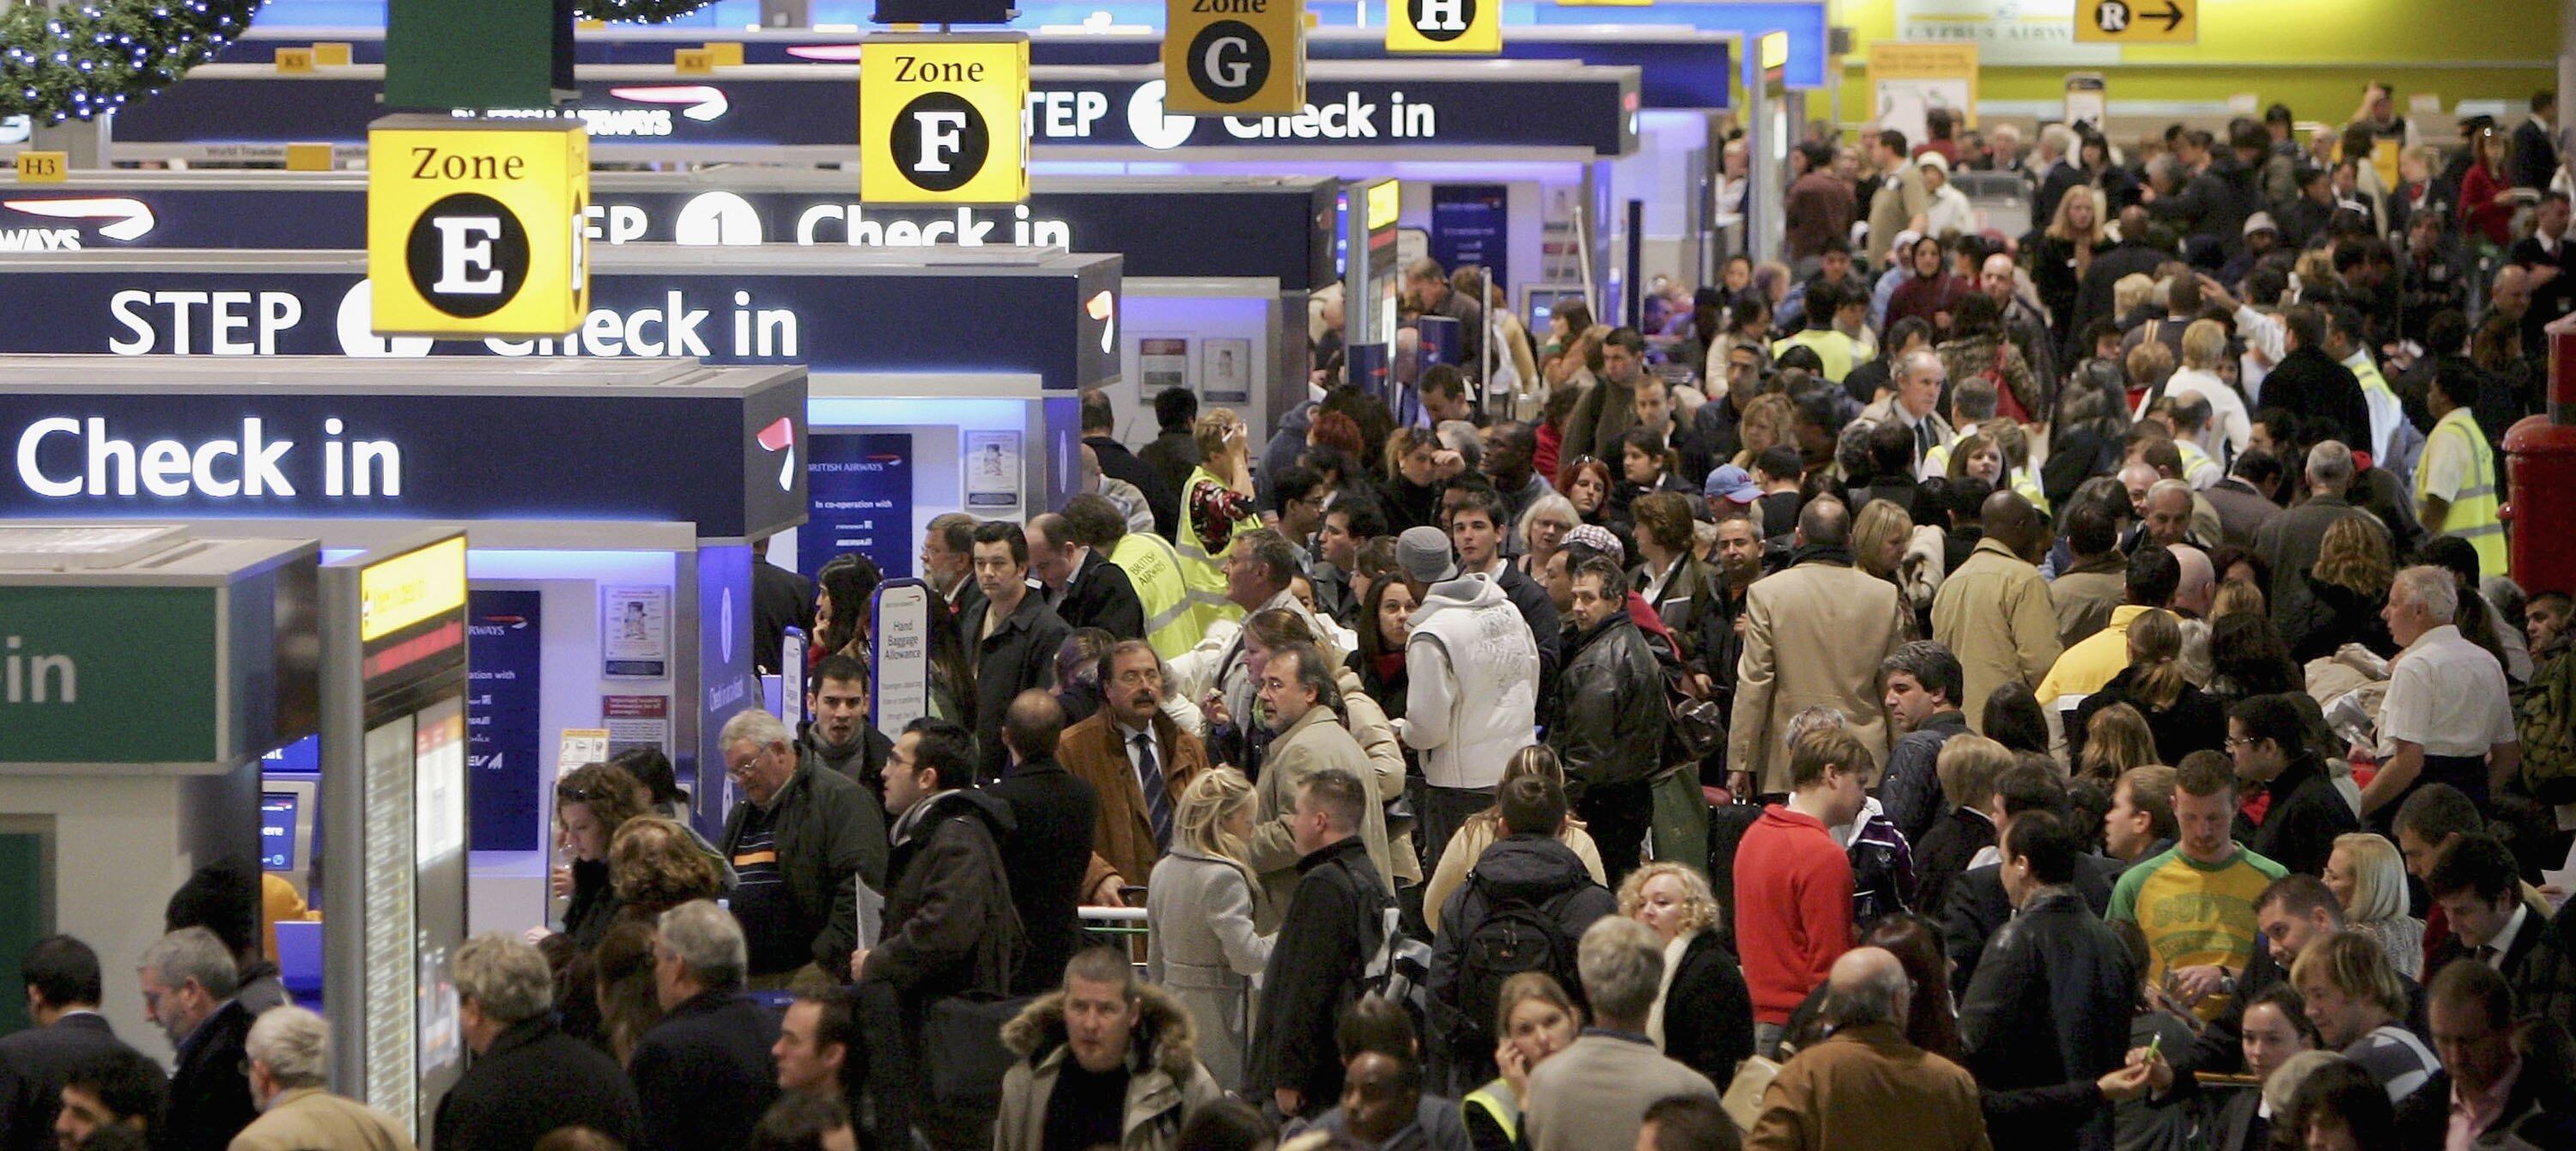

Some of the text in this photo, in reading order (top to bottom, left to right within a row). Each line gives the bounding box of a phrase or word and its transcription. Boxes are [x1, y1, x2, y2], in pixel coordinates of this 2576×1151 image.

[1417, 0, 1466, 30] H
[2100, 3, 2128, 31] R
[895, 57, 985, 82] Zone
[1206, 37, 1251, 88] G
[1391, 92, 1435, 137] in
[913, 112, 966, 172] F
[26, 159, 55, 175] H3
[411, 148, 524, 179] Zone
[797, 205, 994, 247] Check
[1015, 205, 1070, 253] in
[432, 216, 503, 294] E
[109, 290, 301, 356] STEP
[734, 290, 798, 357] in
[17, 417, 400, 497] Check in
[843, 463, 884, 472] AIRWAYS
[875, 499, 893, 509] with
[1128, 551, 1155, 576] BRITIS
[893, 619, 914, 631] Hand
[884, 649, 922, 661] Allowance
[887, 635, 919, 649] Baggage
[7, 636, 77, 703] in
[495, 670, 516, 679] with
